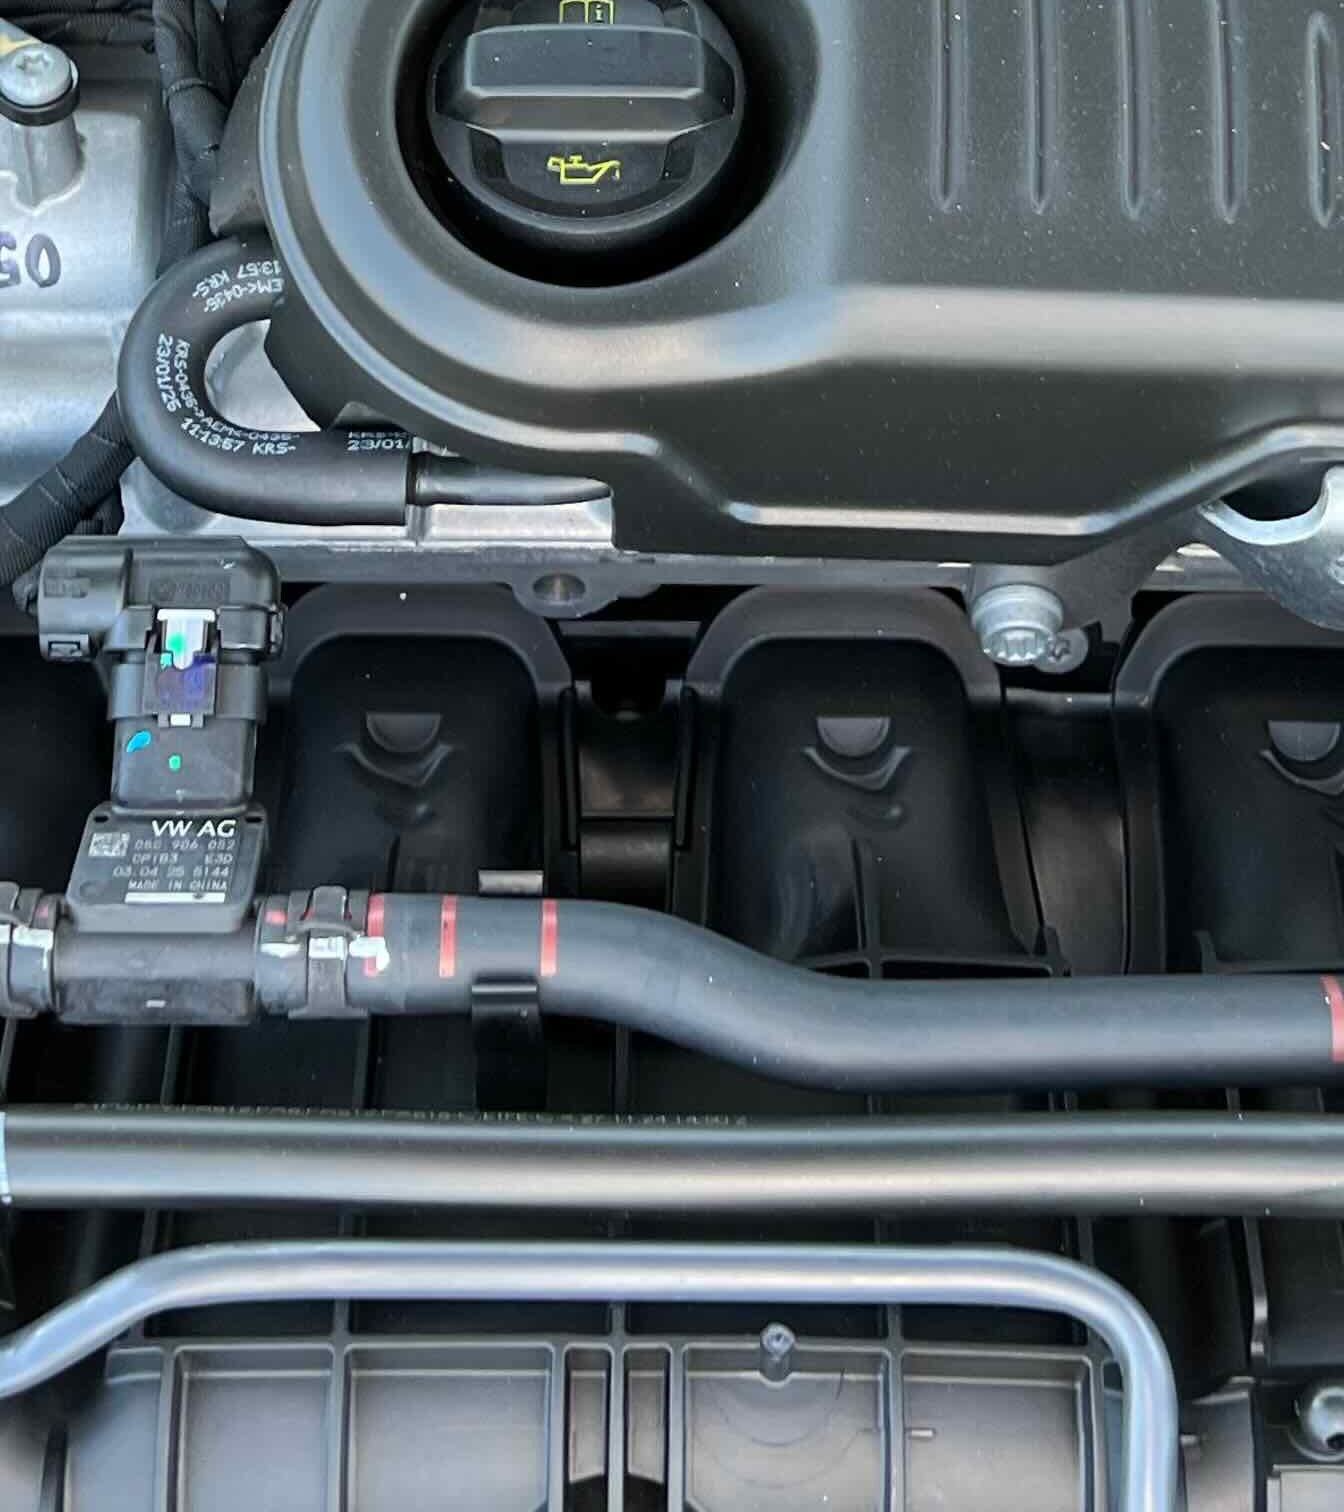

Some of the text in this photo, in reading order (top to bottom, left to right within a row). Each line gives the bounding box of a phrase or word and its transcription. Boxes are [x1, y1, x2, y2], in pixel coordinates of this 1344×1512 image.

[151, 819, 237, 838] VW AG
[127, 879, 228, 891] MADE IN CHINA
